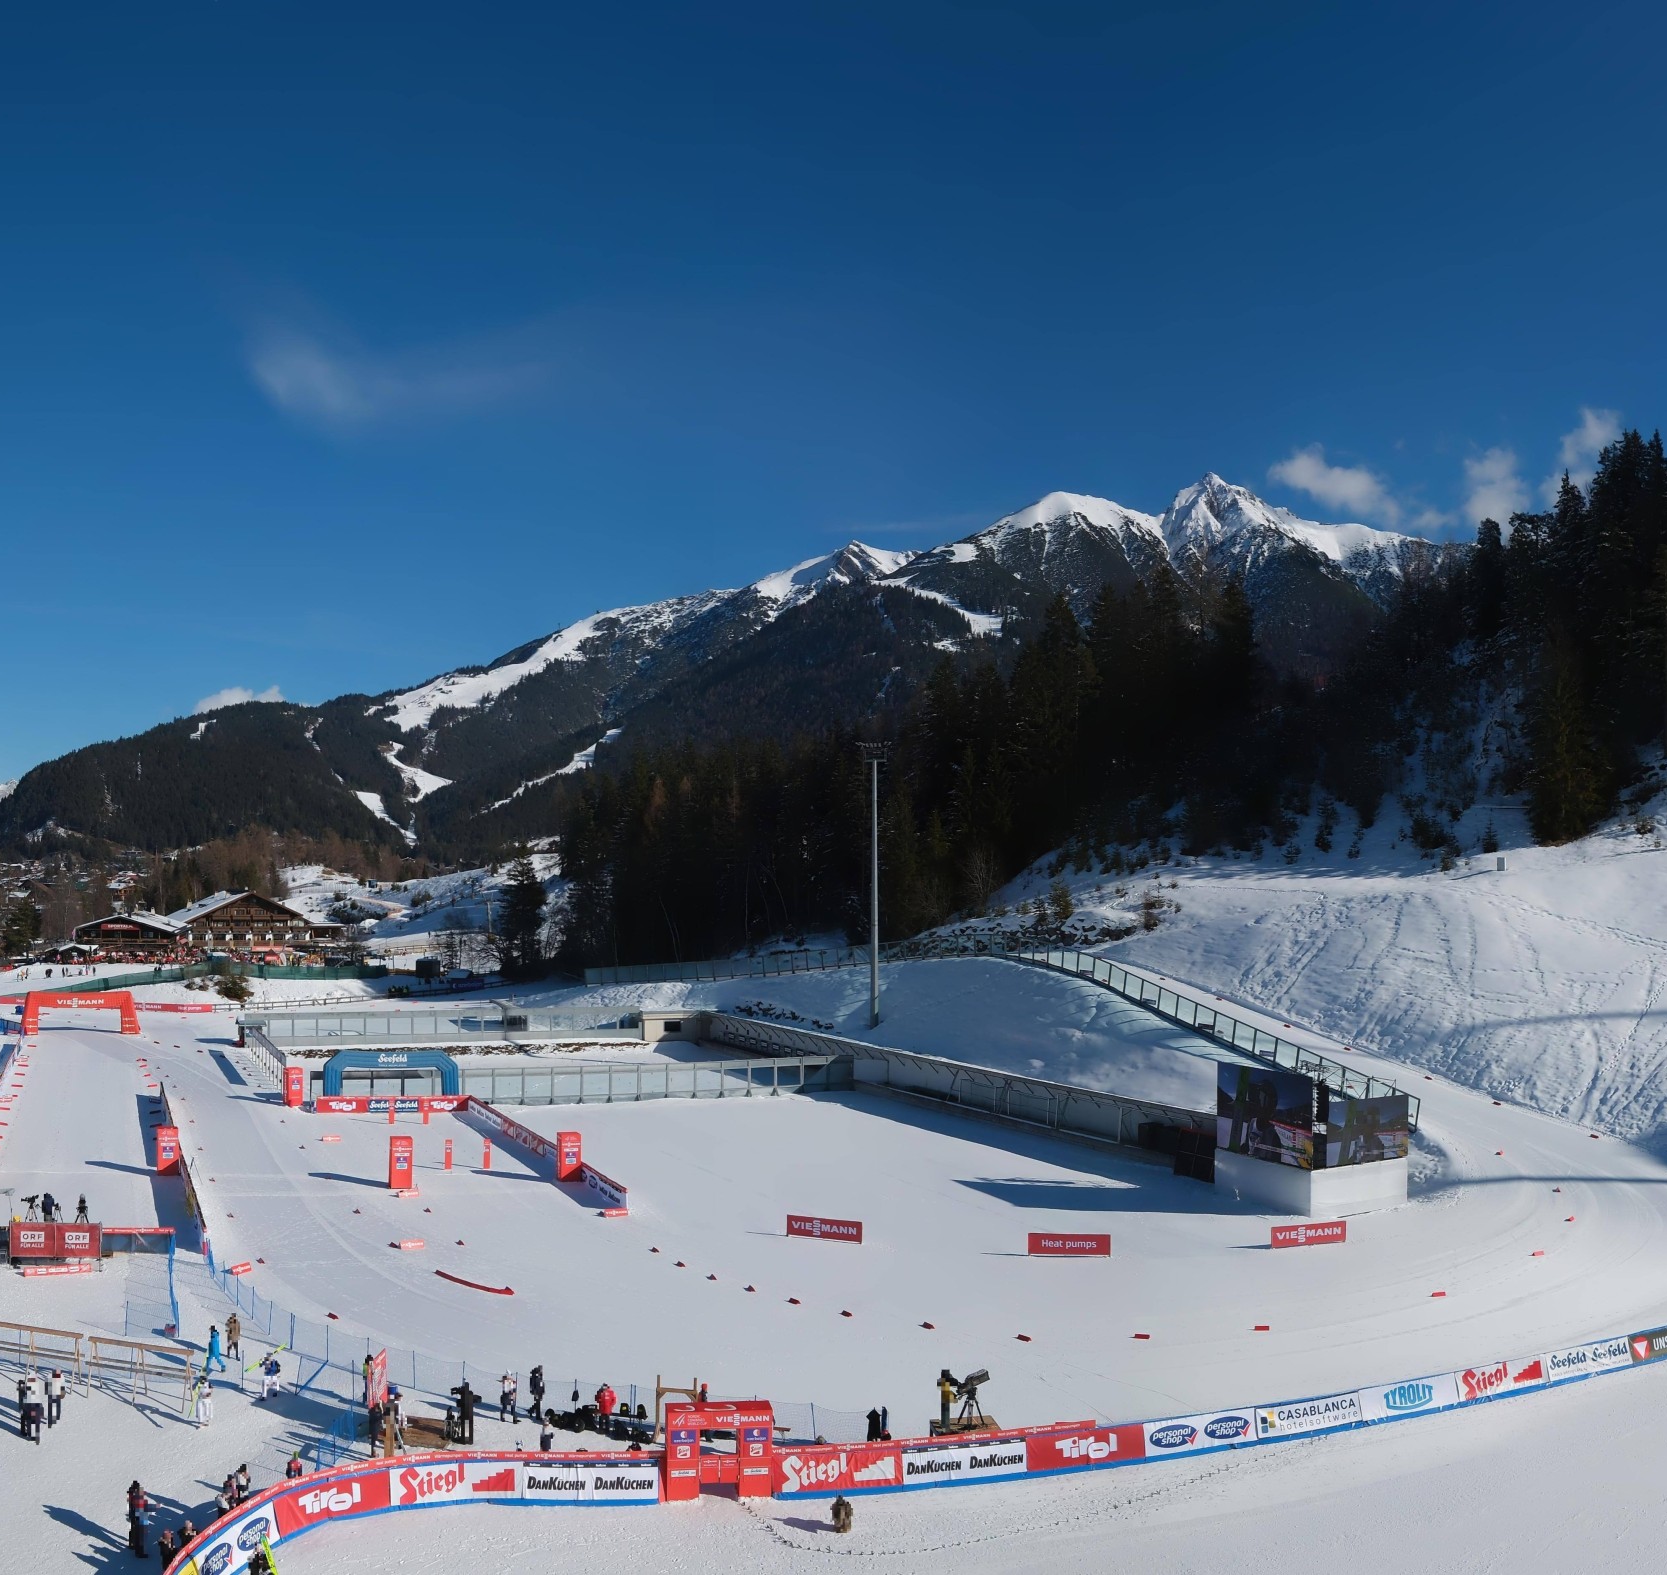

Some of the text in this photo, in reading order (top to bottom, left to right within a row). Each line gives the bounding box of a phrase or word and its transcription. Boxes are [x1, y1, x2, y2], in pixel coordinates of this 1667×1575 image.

[57, 998, 104, 1007] VIESSMANN
[378, 1054, 407, 1064] Seefeld
[329, 1102, 356, 1111] Tirol
[395, 1100, 418, 1109] Seefeld
[430, 1101, 457, 1111] Tirol
[792, 1219, 857, 1236] VIESSMANN
[1276, 1226, 1341, 1242] VIESSMANN
[1042, 1240, 1097, 1249] Heat pumps
[1592, 1342, 1628, 1362] Seefeld
[1550, 1352, 1586, 1370] Seefeld
[1462, 1361, 1508, 1402] Stiegl
[1384, 1384, 1433, 1405] TYROLIT
[1278, 1398, 1356, 1421] CASABLANCA
[716, 1413, 769, 1425] VIESSMANN
[1207, 1419, 1244, 1433] personal
[1279, 1409, 1358, 1432] hotelsoftware
[837, 1443, 865, 1451] VIESSMANN
[1025, 1426, 1051, 1434] VIESSMANN
[1152, 1427, 1192, 1442] personal
[1161, 1434, 1182, 1445] shop
[1215, 1426, 1236, 1437] shop
[1055, 1432, 1118, 1459] Tirol
[342, 1463, 369, 1473] VIESSMANN
[403, 1455, 430, 1464] VIESSMANN
[467, 1451, 497, 1460] VIESSMANN
[535, 1452, 564, 1460] VIESSMANN
[601, 1452, 630, 1460] VIESSMANN
[782, 1452, 848, 1493] Stiegl
[400, 1463, 466, 1505] Stiegl
[299, 1482, 361, 1514] Tirol
[240, 1519, 266, 1546] personal
